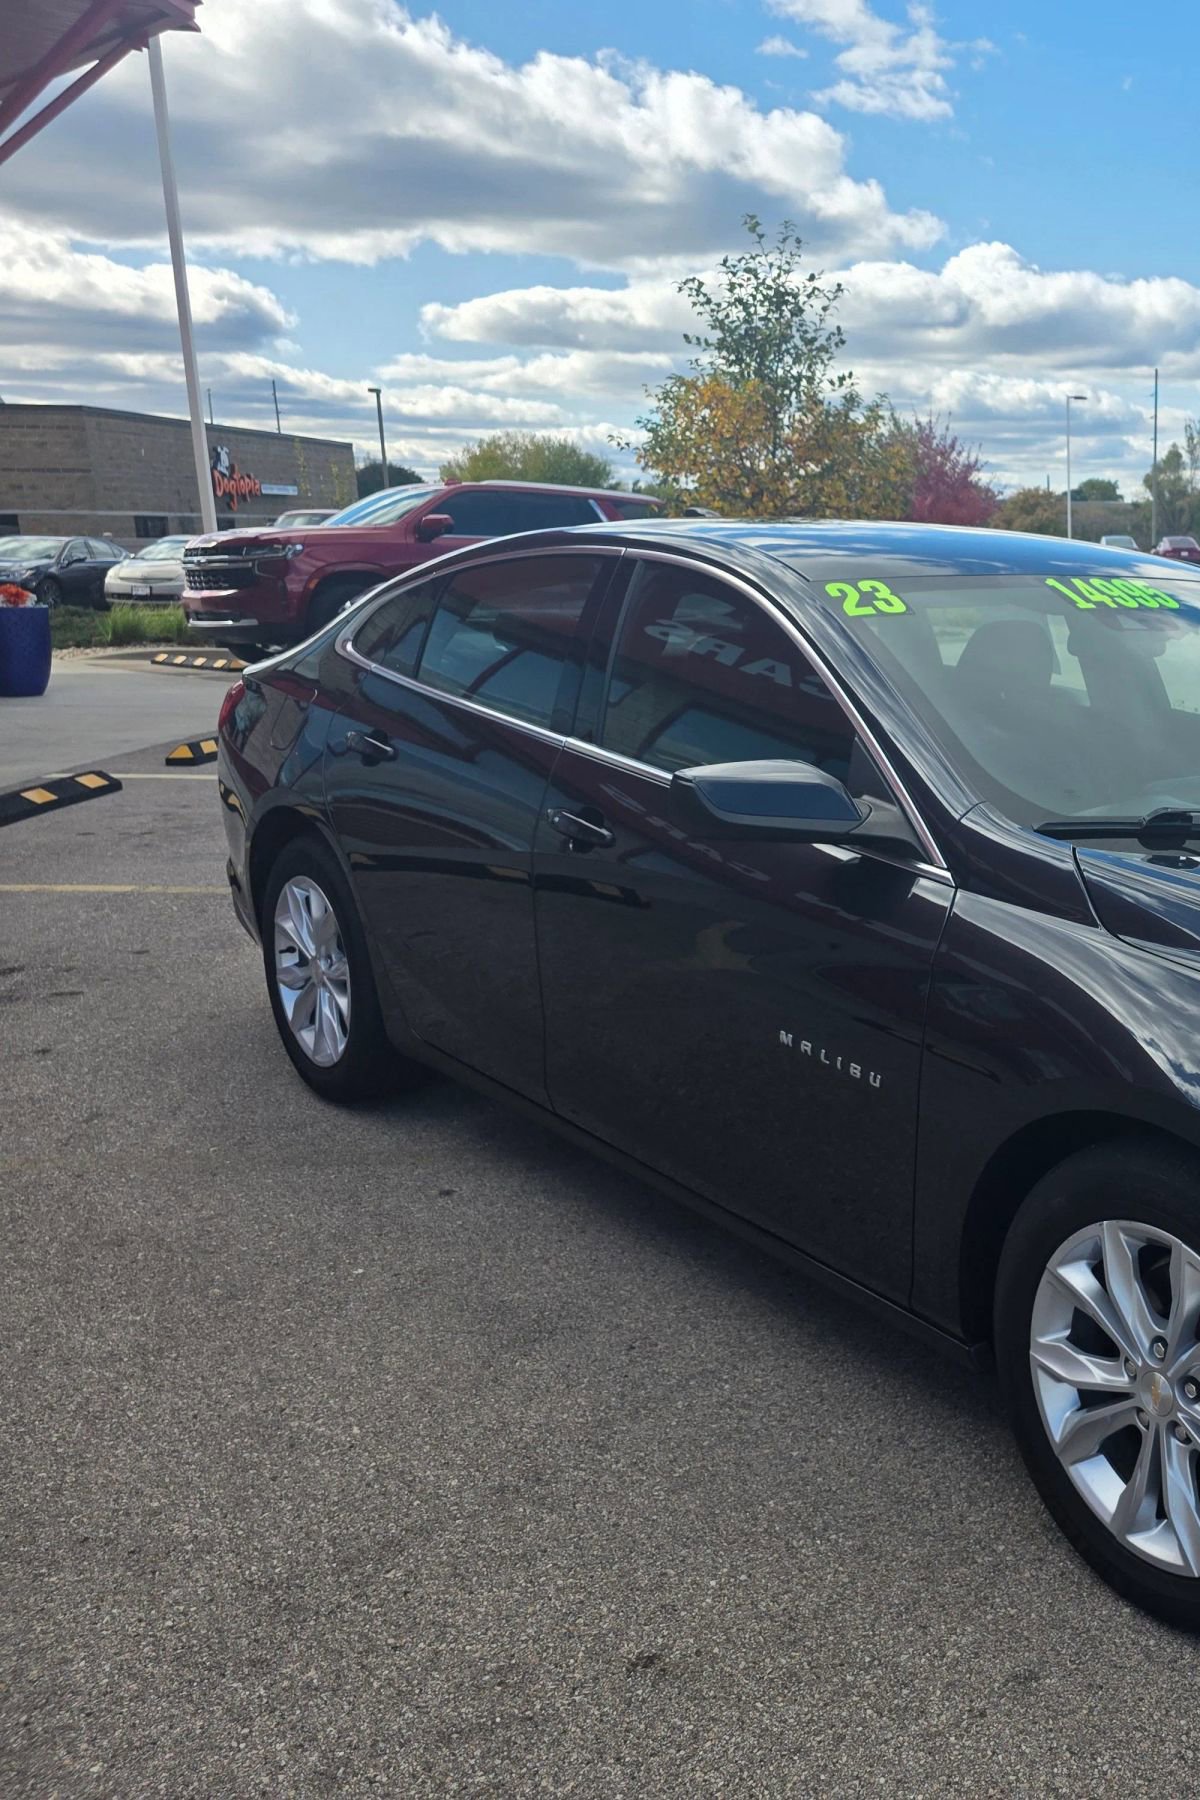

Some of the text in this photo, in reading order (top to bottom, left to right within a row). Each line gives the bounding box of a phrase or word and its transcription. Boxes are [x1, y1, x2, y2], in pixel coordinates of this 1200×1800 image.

[212, 463, 261, 512] Dogtopia
[825, 580, 907, 616] 23
[1045, 578, 1180, 609] 14995
[779, 1030, 882, 1088] MALIBU
